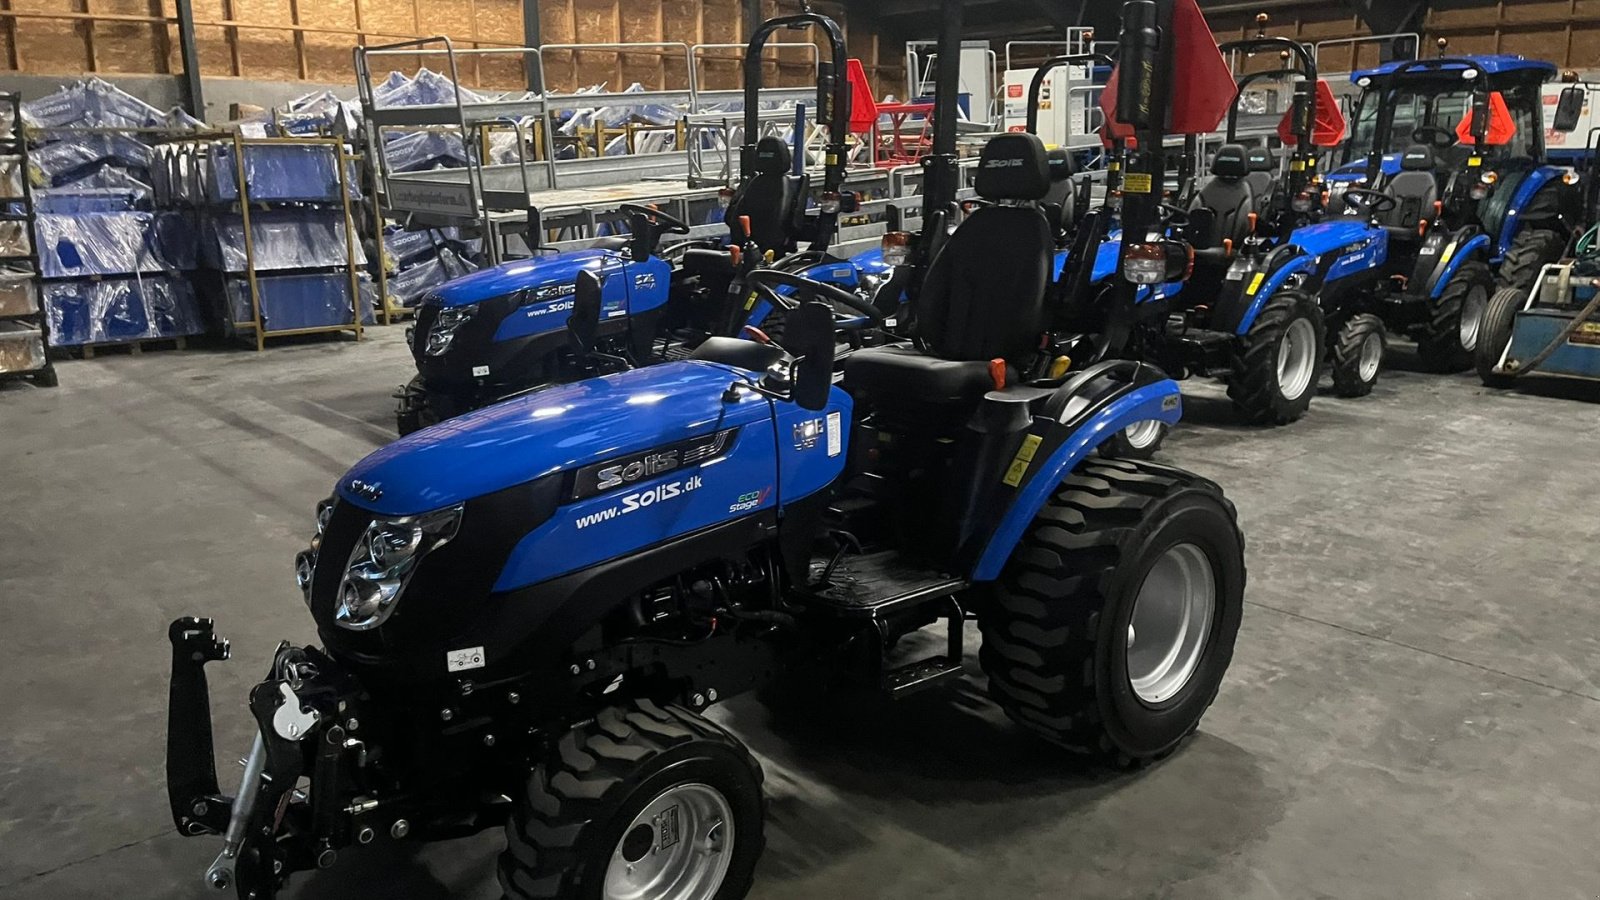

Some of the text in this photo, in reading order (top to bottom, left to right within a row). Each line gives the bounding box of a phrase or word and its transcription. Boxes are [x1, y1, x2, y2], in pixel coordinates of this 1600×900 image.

[597, 449, 679, 490] Solis
[575, 475, 702, 529] www.Solis.dk
[729, 499, 759, 513] Stage
